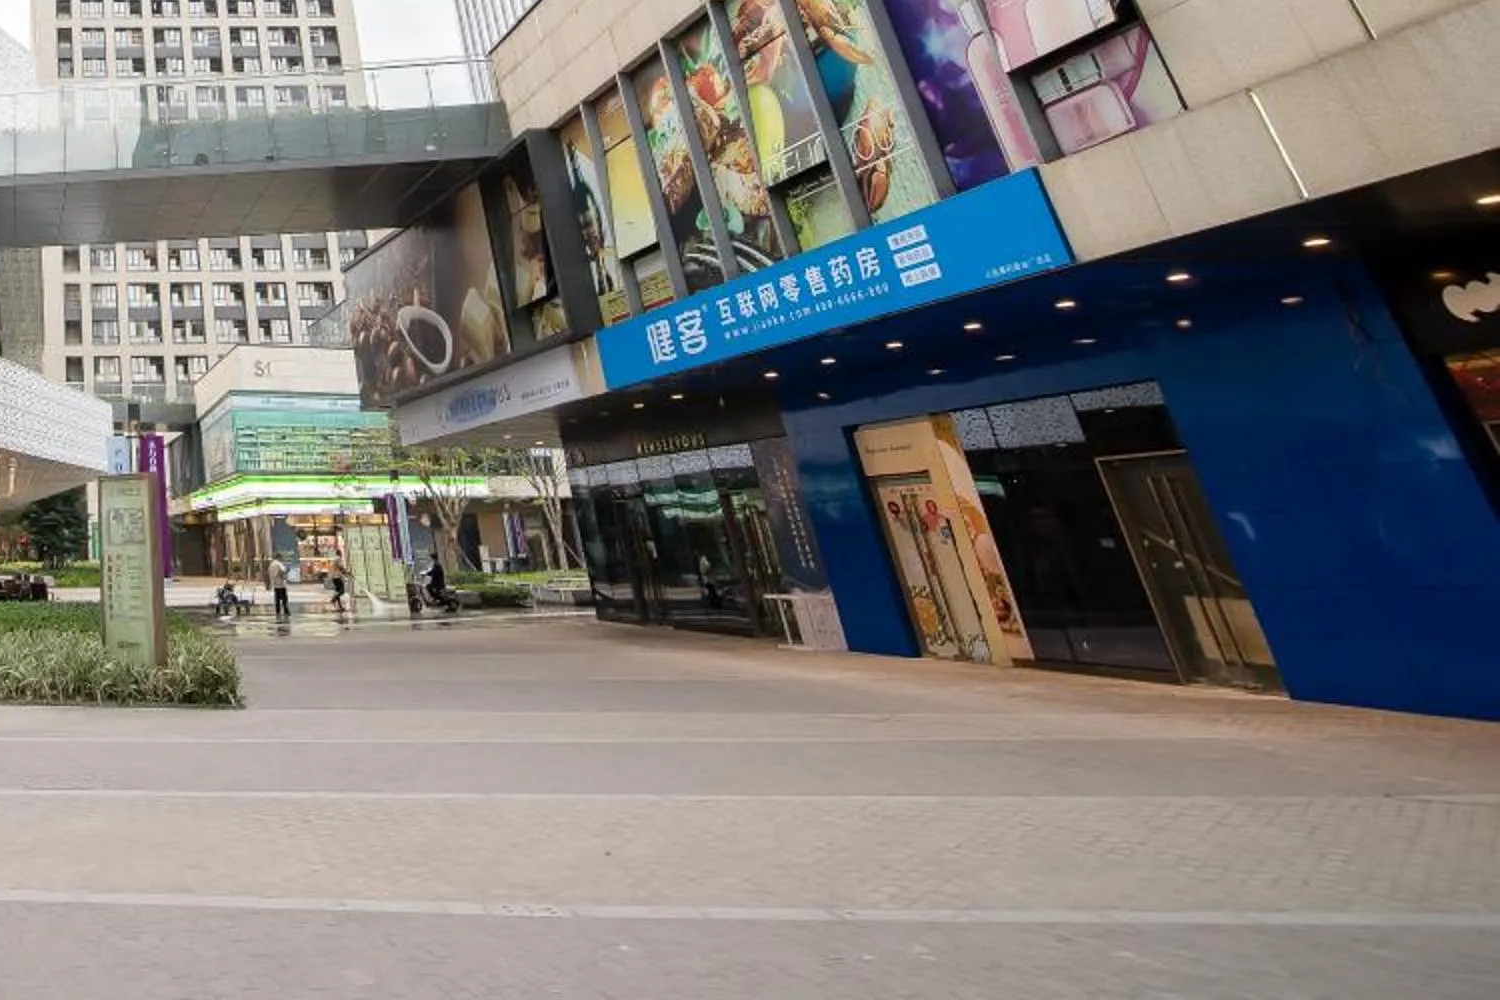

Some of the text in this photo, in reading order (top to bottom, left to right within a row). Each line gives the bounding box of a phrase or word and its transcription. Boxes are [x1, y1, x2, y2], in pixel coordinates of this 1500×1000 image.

[646, 247, 881, 365] 健客 互联网零售药房
[254, 360, 272, 377] S1
